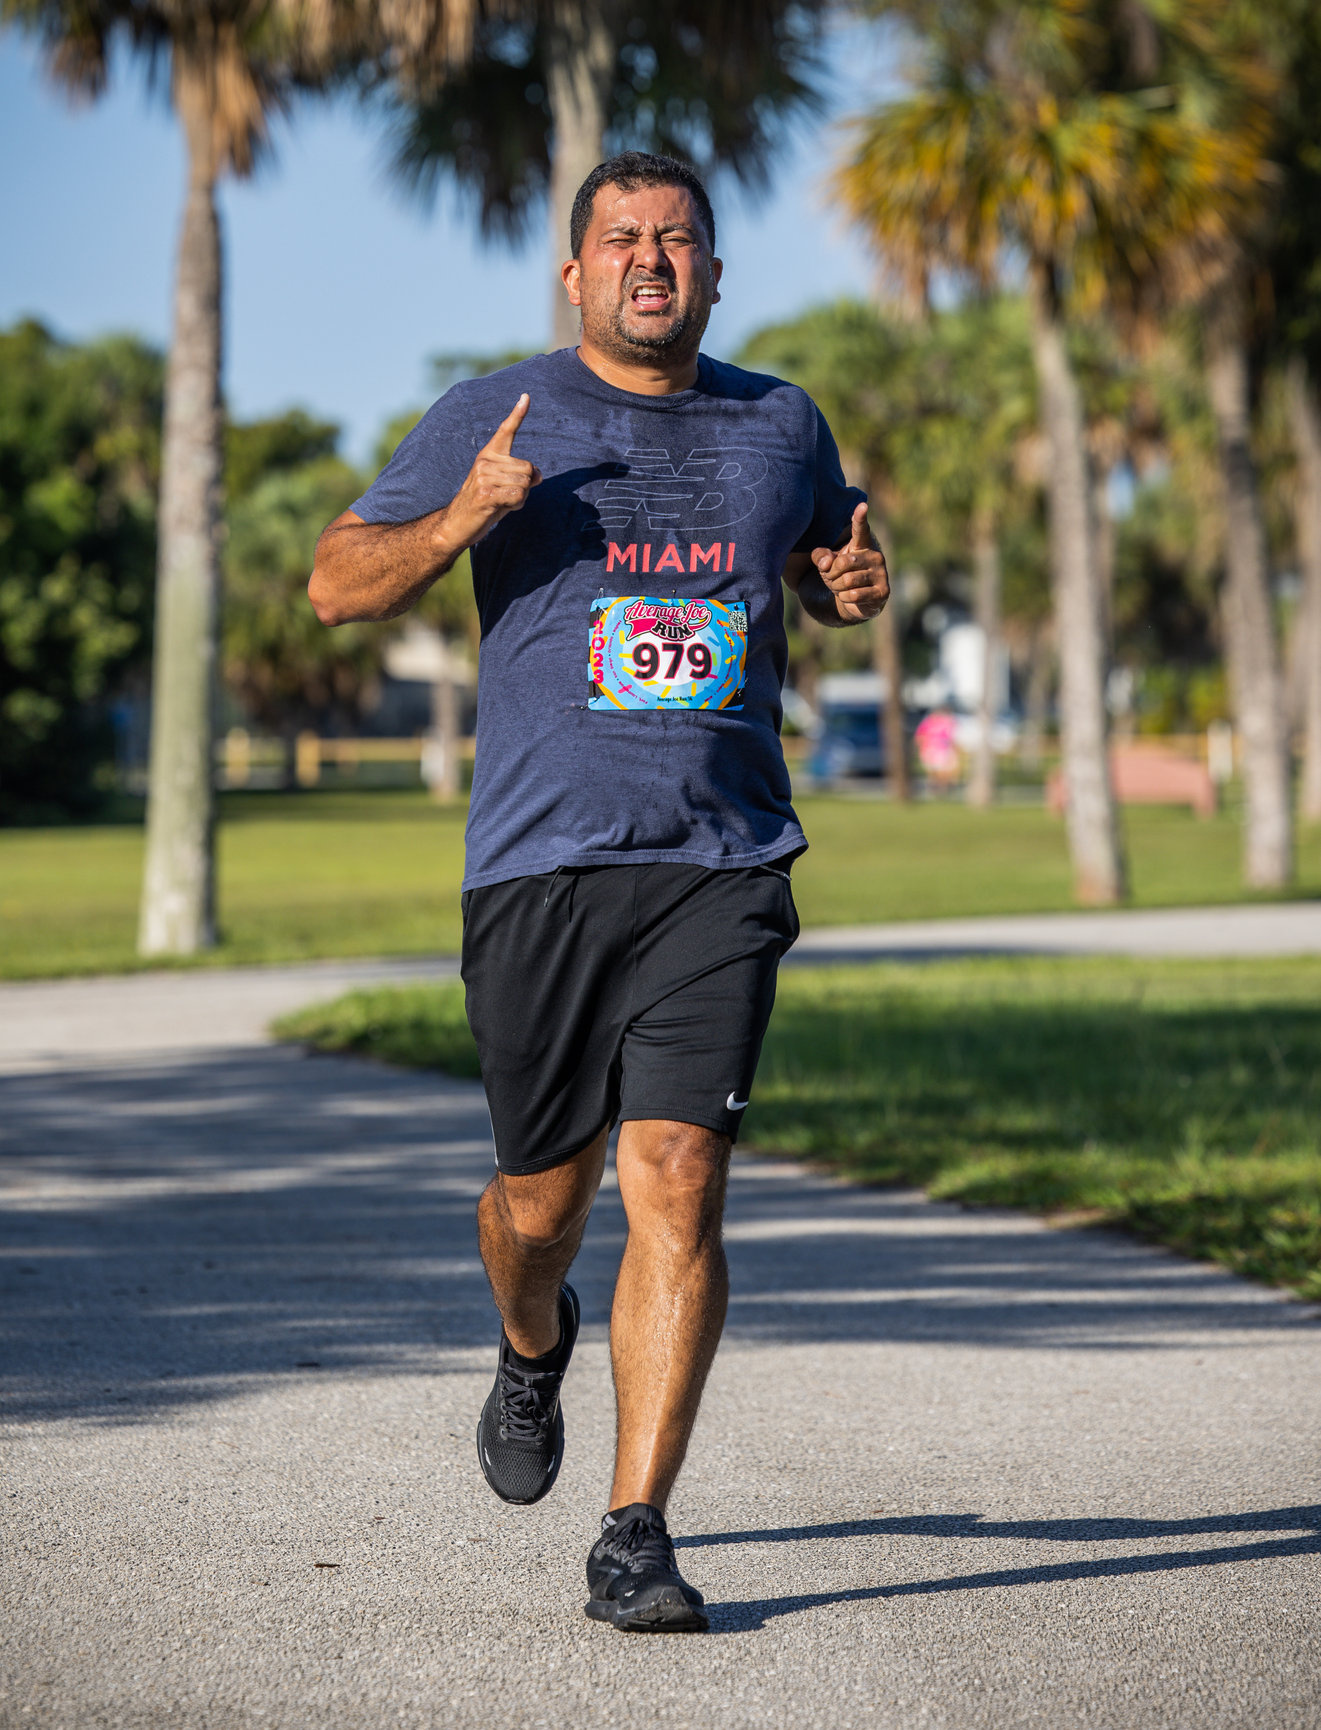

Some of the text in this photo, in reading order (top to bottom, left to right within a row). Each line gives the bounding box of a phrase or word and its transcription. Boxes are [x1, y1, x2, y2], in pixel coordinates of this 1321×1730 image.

[605, 541, 736, 573] MIAMI
[625, 601, 710, 623] Average Joe
[651, 621, 694, 640] RUN
[591, 620, 606, 685] 2023
[631, 642, 713, 681] 979
